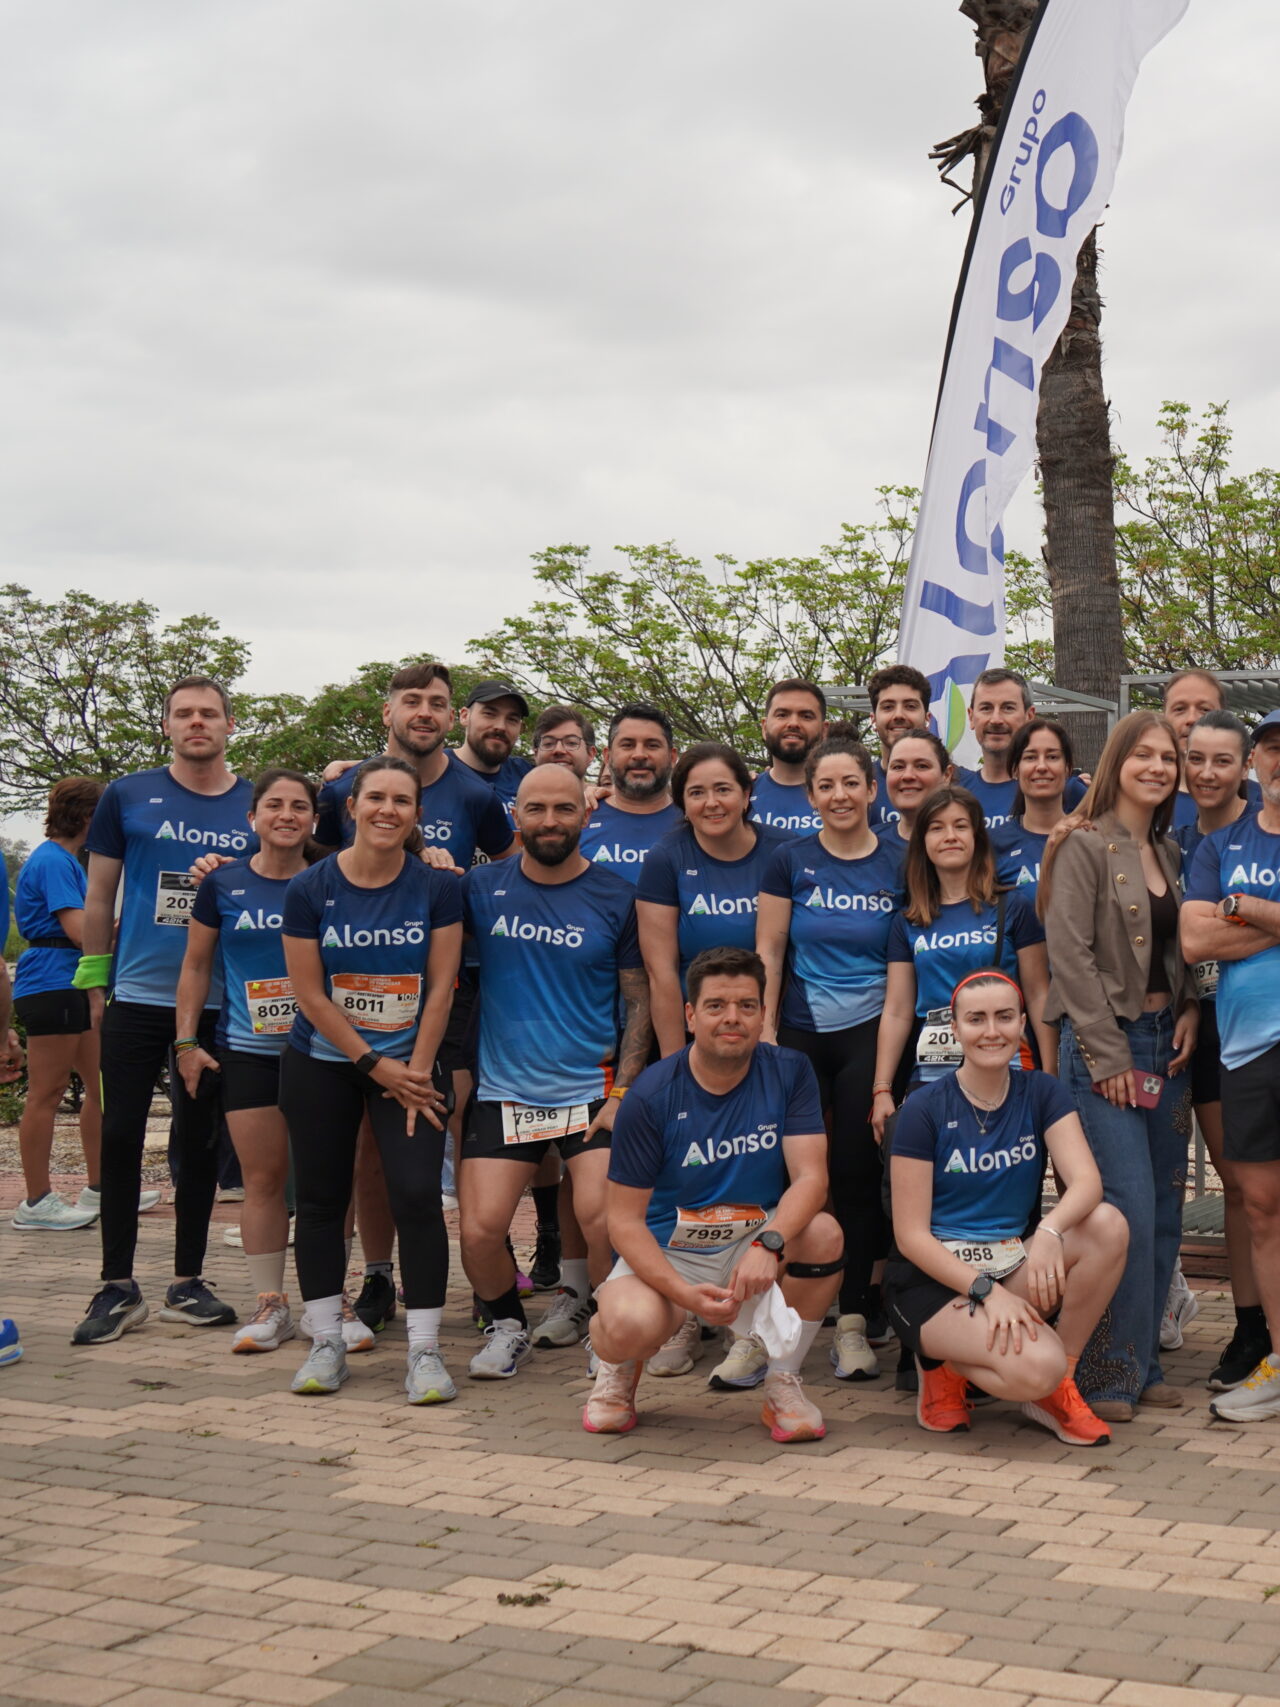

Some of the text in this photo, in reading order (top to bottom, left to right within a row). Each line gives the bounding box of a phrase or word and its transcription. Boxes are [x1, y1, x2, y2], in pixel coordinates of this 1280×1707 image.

[1000, 89, 1046, 215] Grupo
[154, 820, 247, 850] Alonso
[688, 893, 760, 915] Alons
[805, 885, 893, 913] Alonso
[234, 909, 283, 930] Alo
[404, 920, 424, 928] Grupo
[322, 924, 424, 948] Alonso
[490, 915, 583, 948] Alonso
[914, 929, 997, 955] Alonso
[257, 1002, 299, 1018] 8026
[344, 996, 384, 1013] 8011
[928, 1032, 957, 1044] 201
[512, 1109, 558, 1126] 7996
[758, 1123, 777, 1131] Grupo
[681, 1131, 777, 1167] Alonso
[944, 1142, 1036, 1173] Alonso
[685, 1228, 734, 1240] 7992
[953, 1247, 994, 1262] 1958
